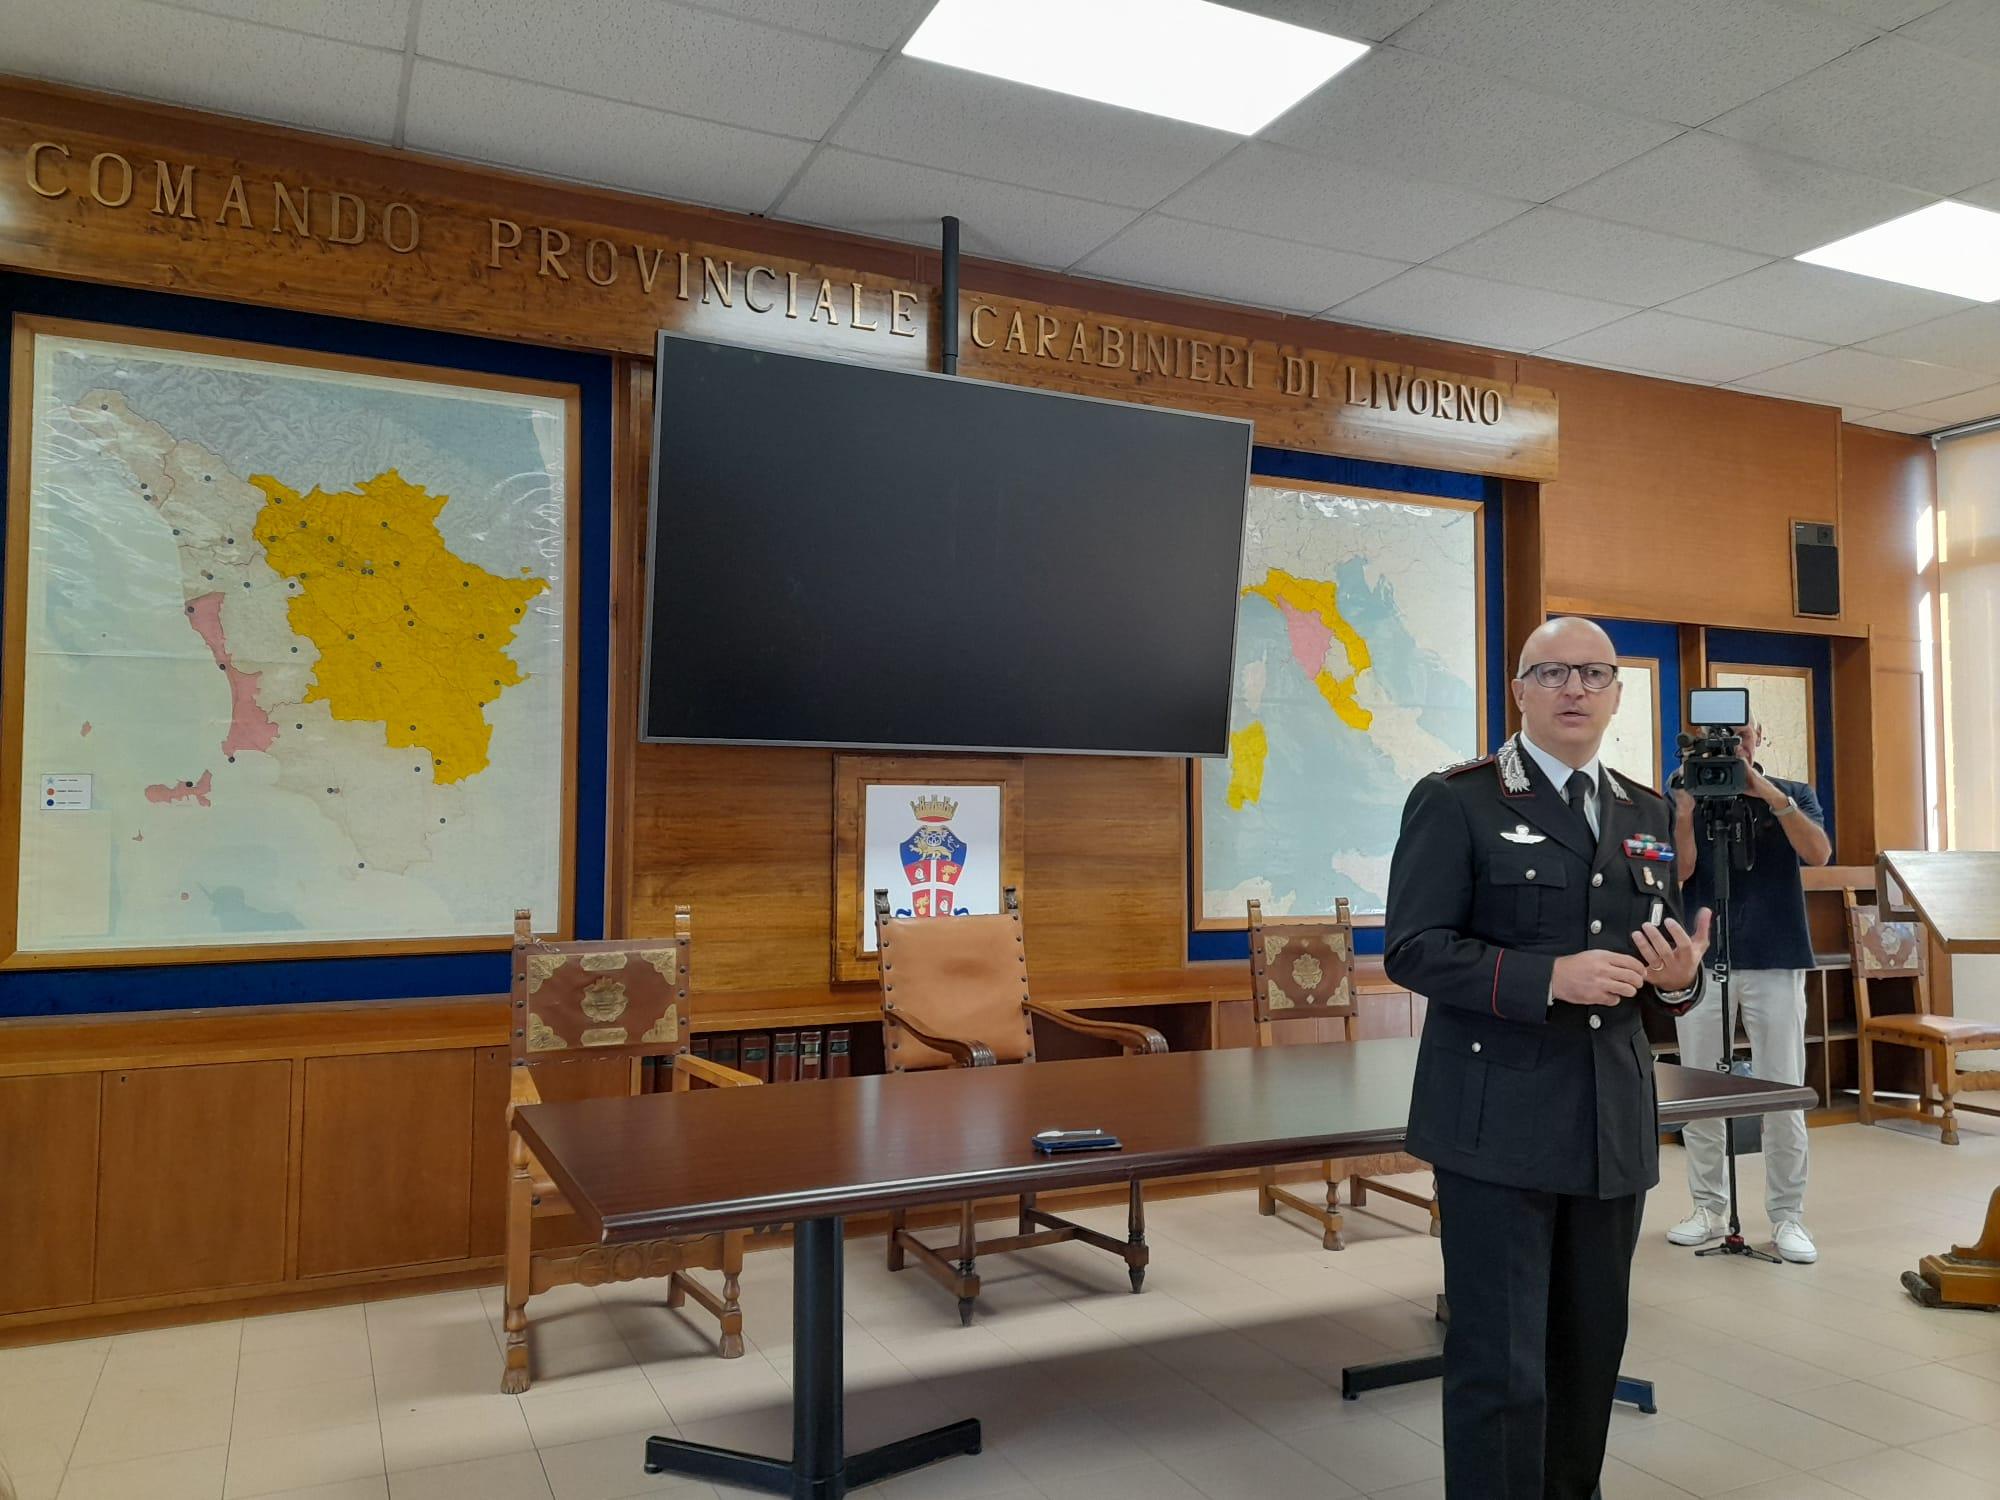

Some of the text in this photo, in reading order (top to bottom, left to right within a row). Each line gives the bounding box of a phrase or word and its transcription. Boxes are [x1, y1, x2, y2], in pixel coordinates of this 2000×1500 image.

[25, 142, 1501, 426] COMANDO PROVINCIALE CARABINIERI DI LIVORNO
